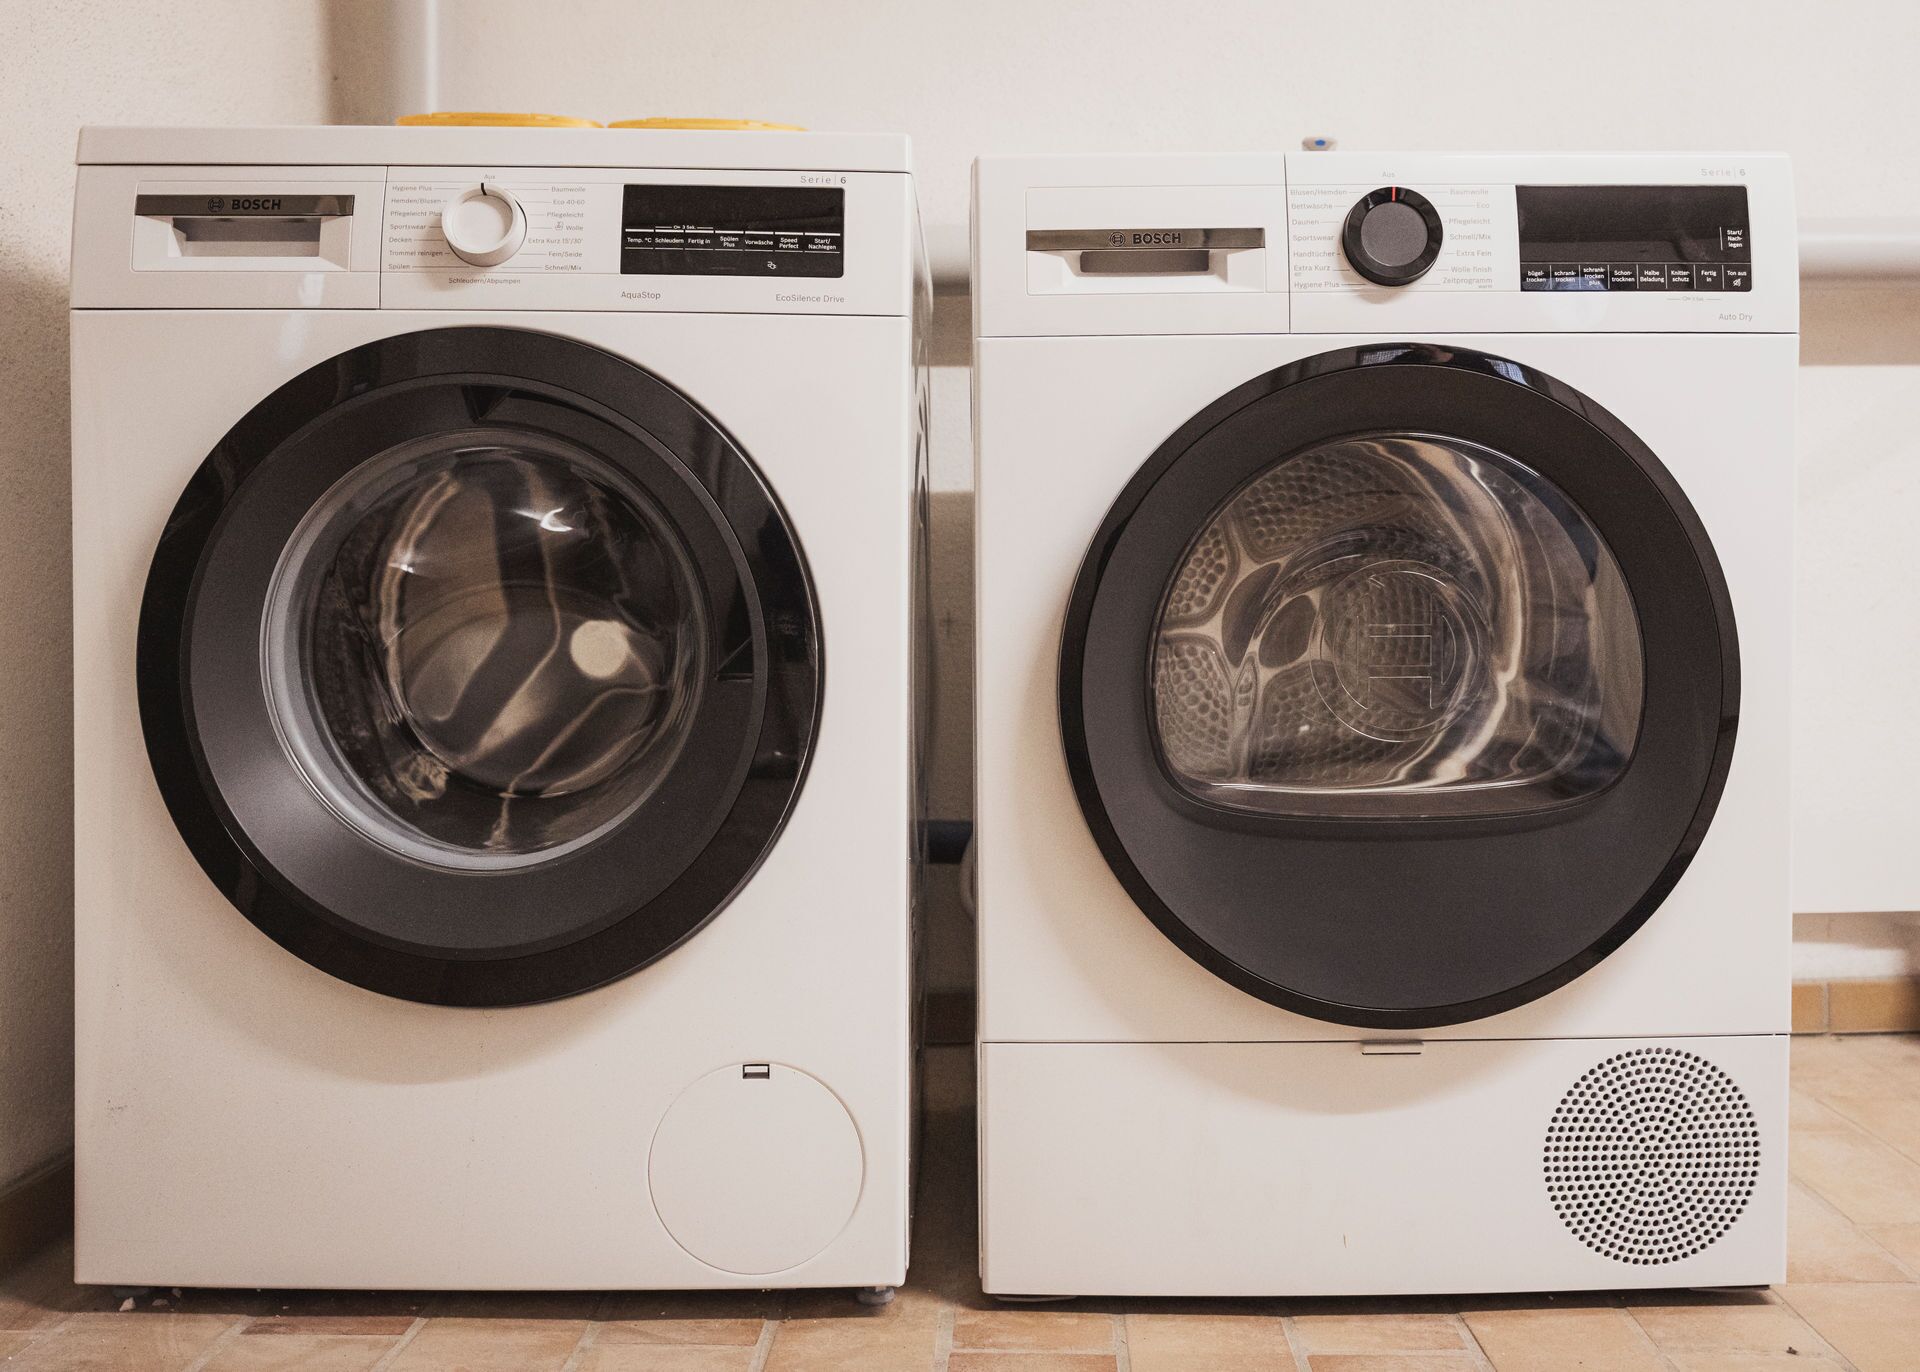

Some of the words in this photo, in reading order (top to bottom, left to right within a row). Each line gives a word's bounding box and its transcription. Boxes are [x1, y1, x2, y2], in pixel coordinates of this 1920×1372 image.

[1701, 168, 1731, 176] Serie
[1740, 168, 1746, 176] 6
[800, 175, 832, 184] Serie
[840, 176, 846, 184] 6
[231, 199, 281, 210] BOSCH
[1132, 233, 1182, 244] BOSCH
[1442, 277, 1493, 285] Zeitprogramm
[621, 291, 661, 300] AquaStop
[775, 294, 821, 302] EcoSilence
[823, 295, 845, 303] Drive
